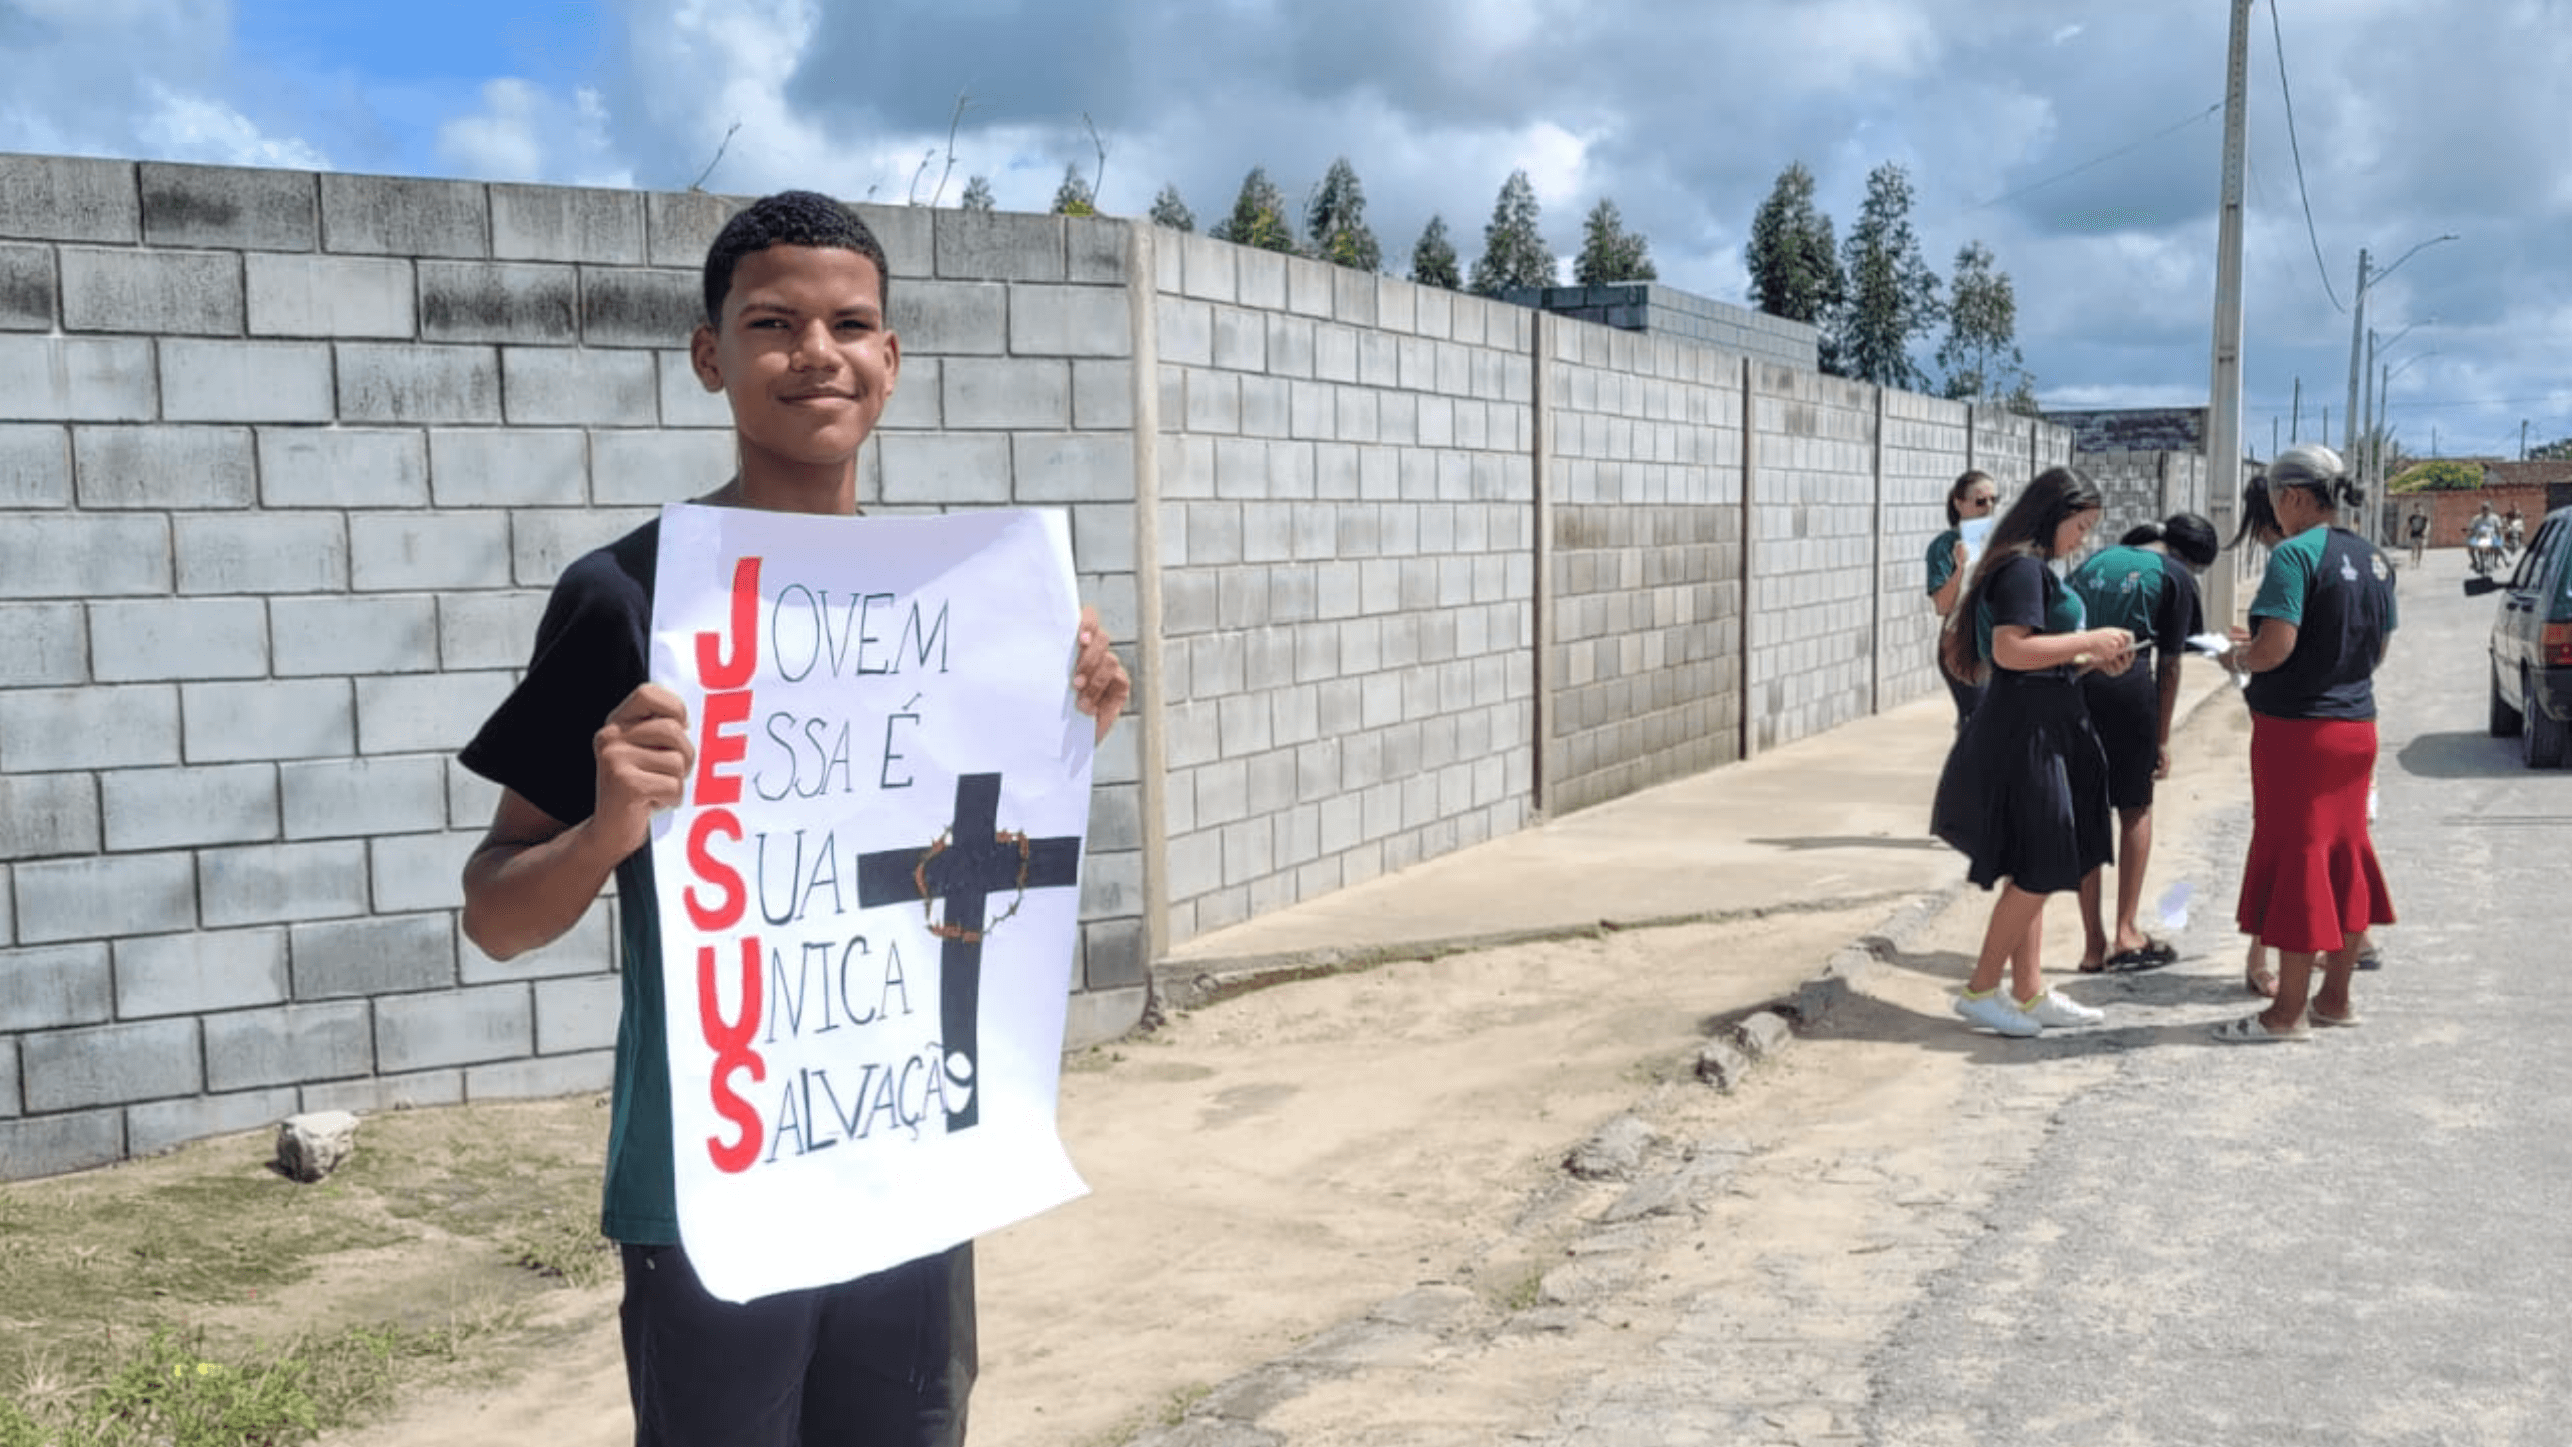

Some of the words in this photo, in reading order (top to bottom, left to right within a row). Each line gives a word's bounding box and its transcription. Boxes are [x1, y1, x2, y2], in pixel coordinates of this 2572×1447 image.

[694, 556, 950, 691] JOVEM
[693, 689, 853, 806] ESSA
[880, 692, 922, 789] É
[683, 807, 846, 932] SUA
